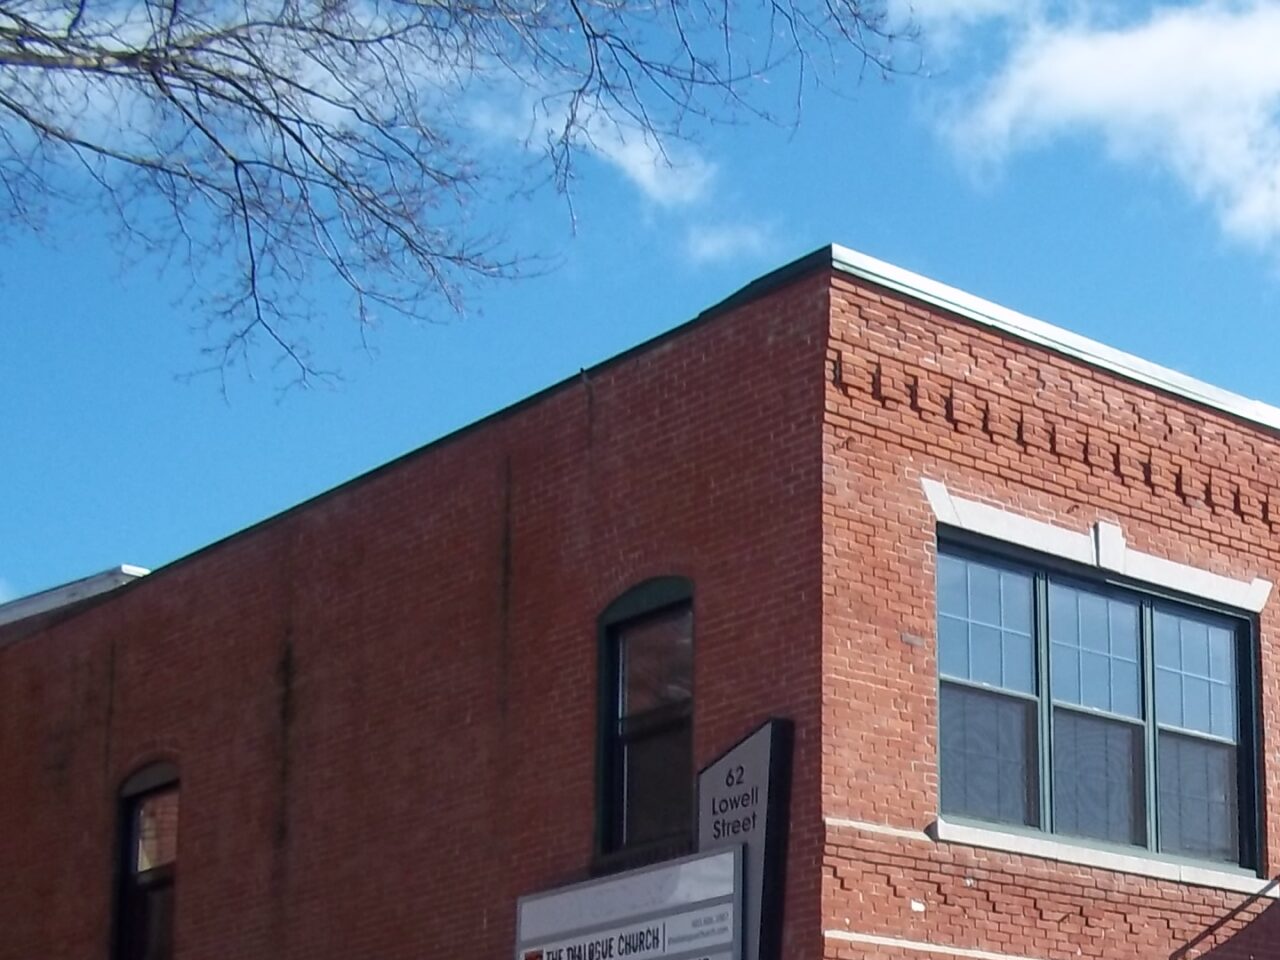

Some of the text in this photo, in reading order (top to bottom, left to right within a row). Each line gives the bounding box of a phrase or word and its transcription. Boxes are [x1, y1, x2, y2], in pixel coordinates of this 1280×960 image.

[725, 765, 745, 788] 62
[711, 786, 759, 816] Lowell
[712, 810, 757, 840] Street
[617, 926, 660, 956] CHURCH
